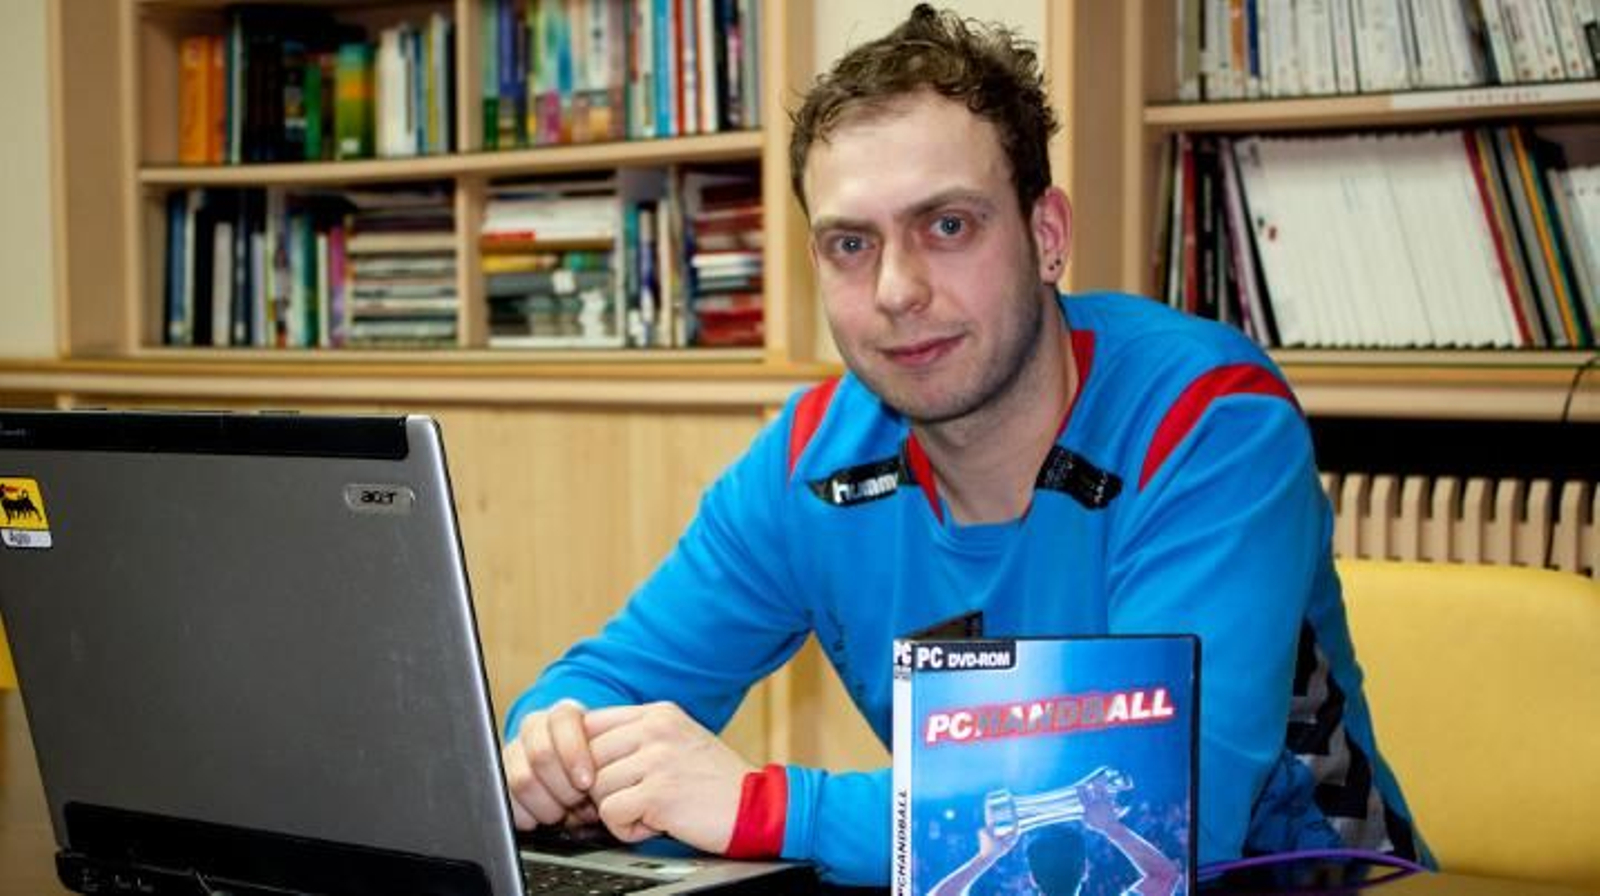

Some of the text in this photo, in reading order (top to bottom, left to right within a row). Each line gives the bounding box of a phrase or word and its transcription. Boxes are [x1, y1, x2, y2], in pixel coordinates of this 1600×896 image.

[361, 490, 398, 504] acer
[893, 640, 911, 665] PC
[917, 646, 1010, 668] PC DVD-ROM
[926, 689, 1174, 742] PCHANDBALL
